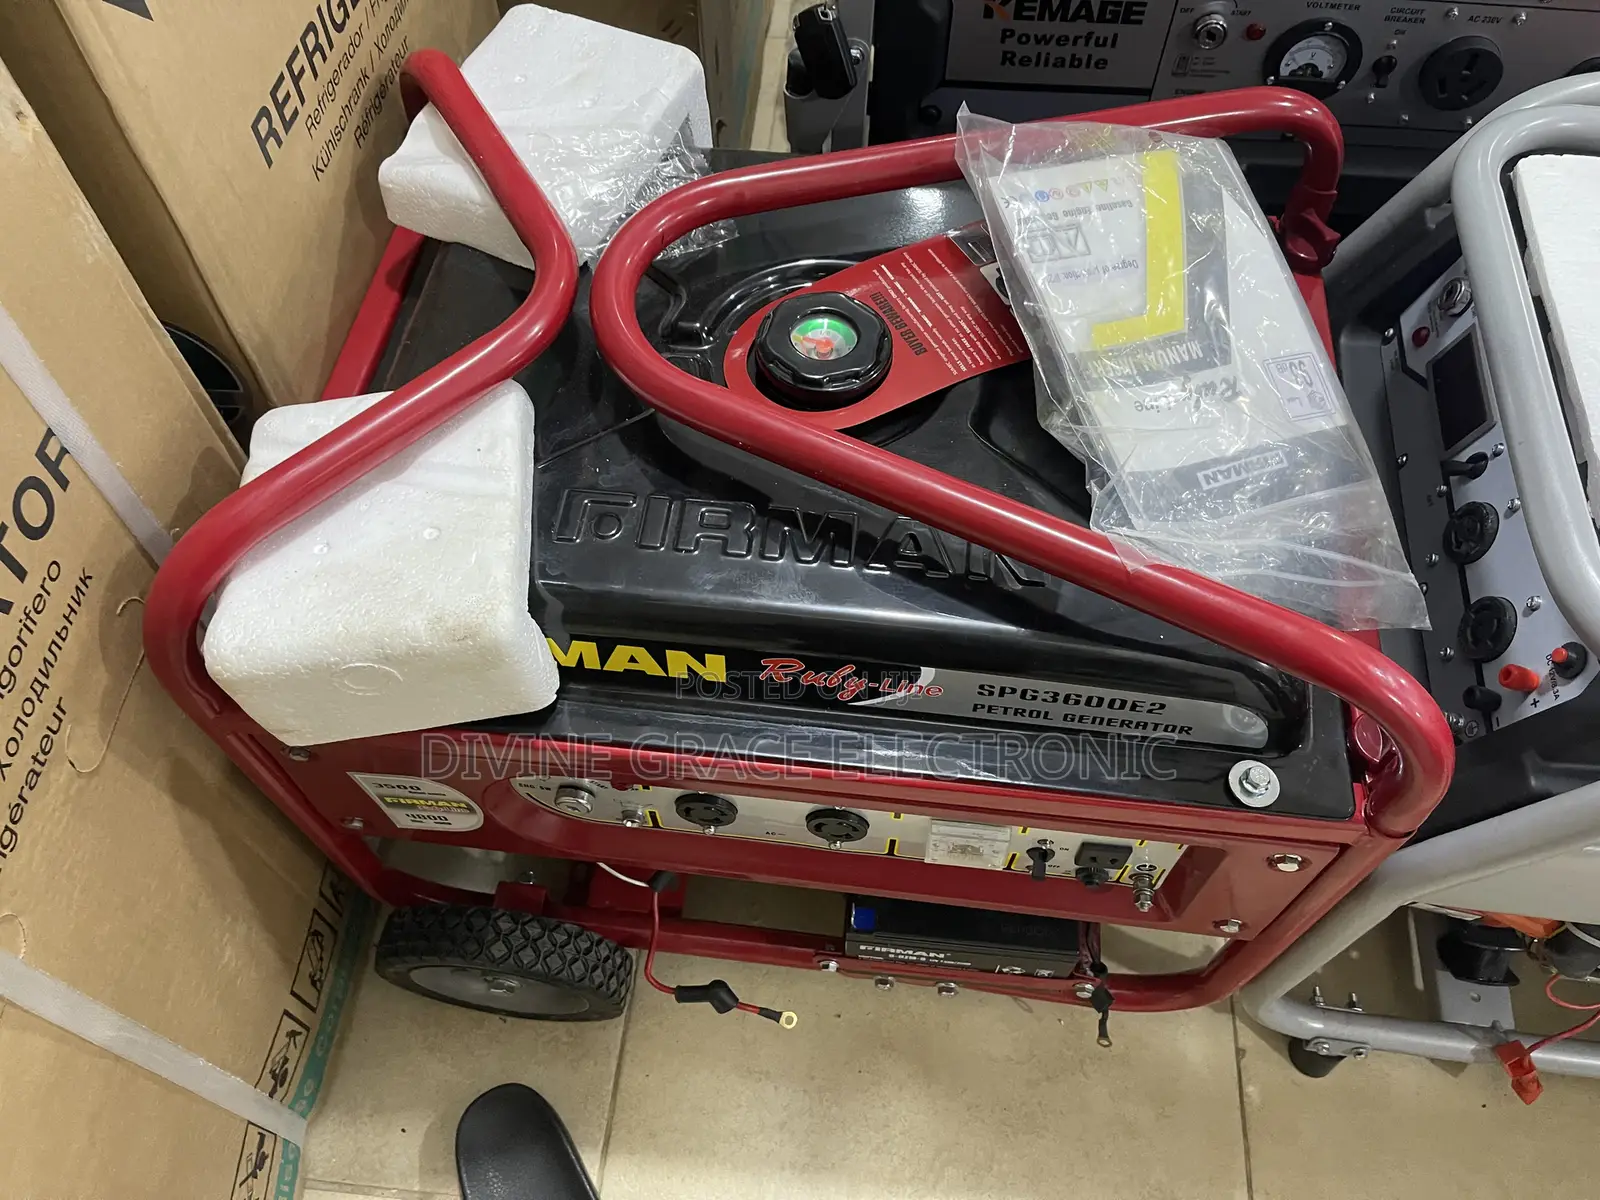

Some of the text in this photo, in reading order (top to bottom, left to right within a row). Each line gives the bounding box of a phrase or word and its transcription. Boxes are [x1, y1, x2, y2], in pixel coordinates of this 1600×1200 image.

[982, 0, 1147, 25] KEMAGE
[1305, 1, 1361, 11] VOLTMETER
[1390, 7, 1426, 15] CIRCUIT
[1384, 16, 1426, 24] BREAKER
[1000, 28, 1119, 50] Powerful
[1000, 51, 1109, 71] Reliable
[251, 0, 361, 169] REFRIG
[305, 22, 365, 140] Refrigerador
[312, 68, 371, 182] Kühlschrank
[899, 328, 927, 355] BUYER
[977, 683, 1168, 716] SPG3600E2
[971, 703, 1194, 737] PETROL GENERATOR
[859, 944, 945, 959] FIRMAN
